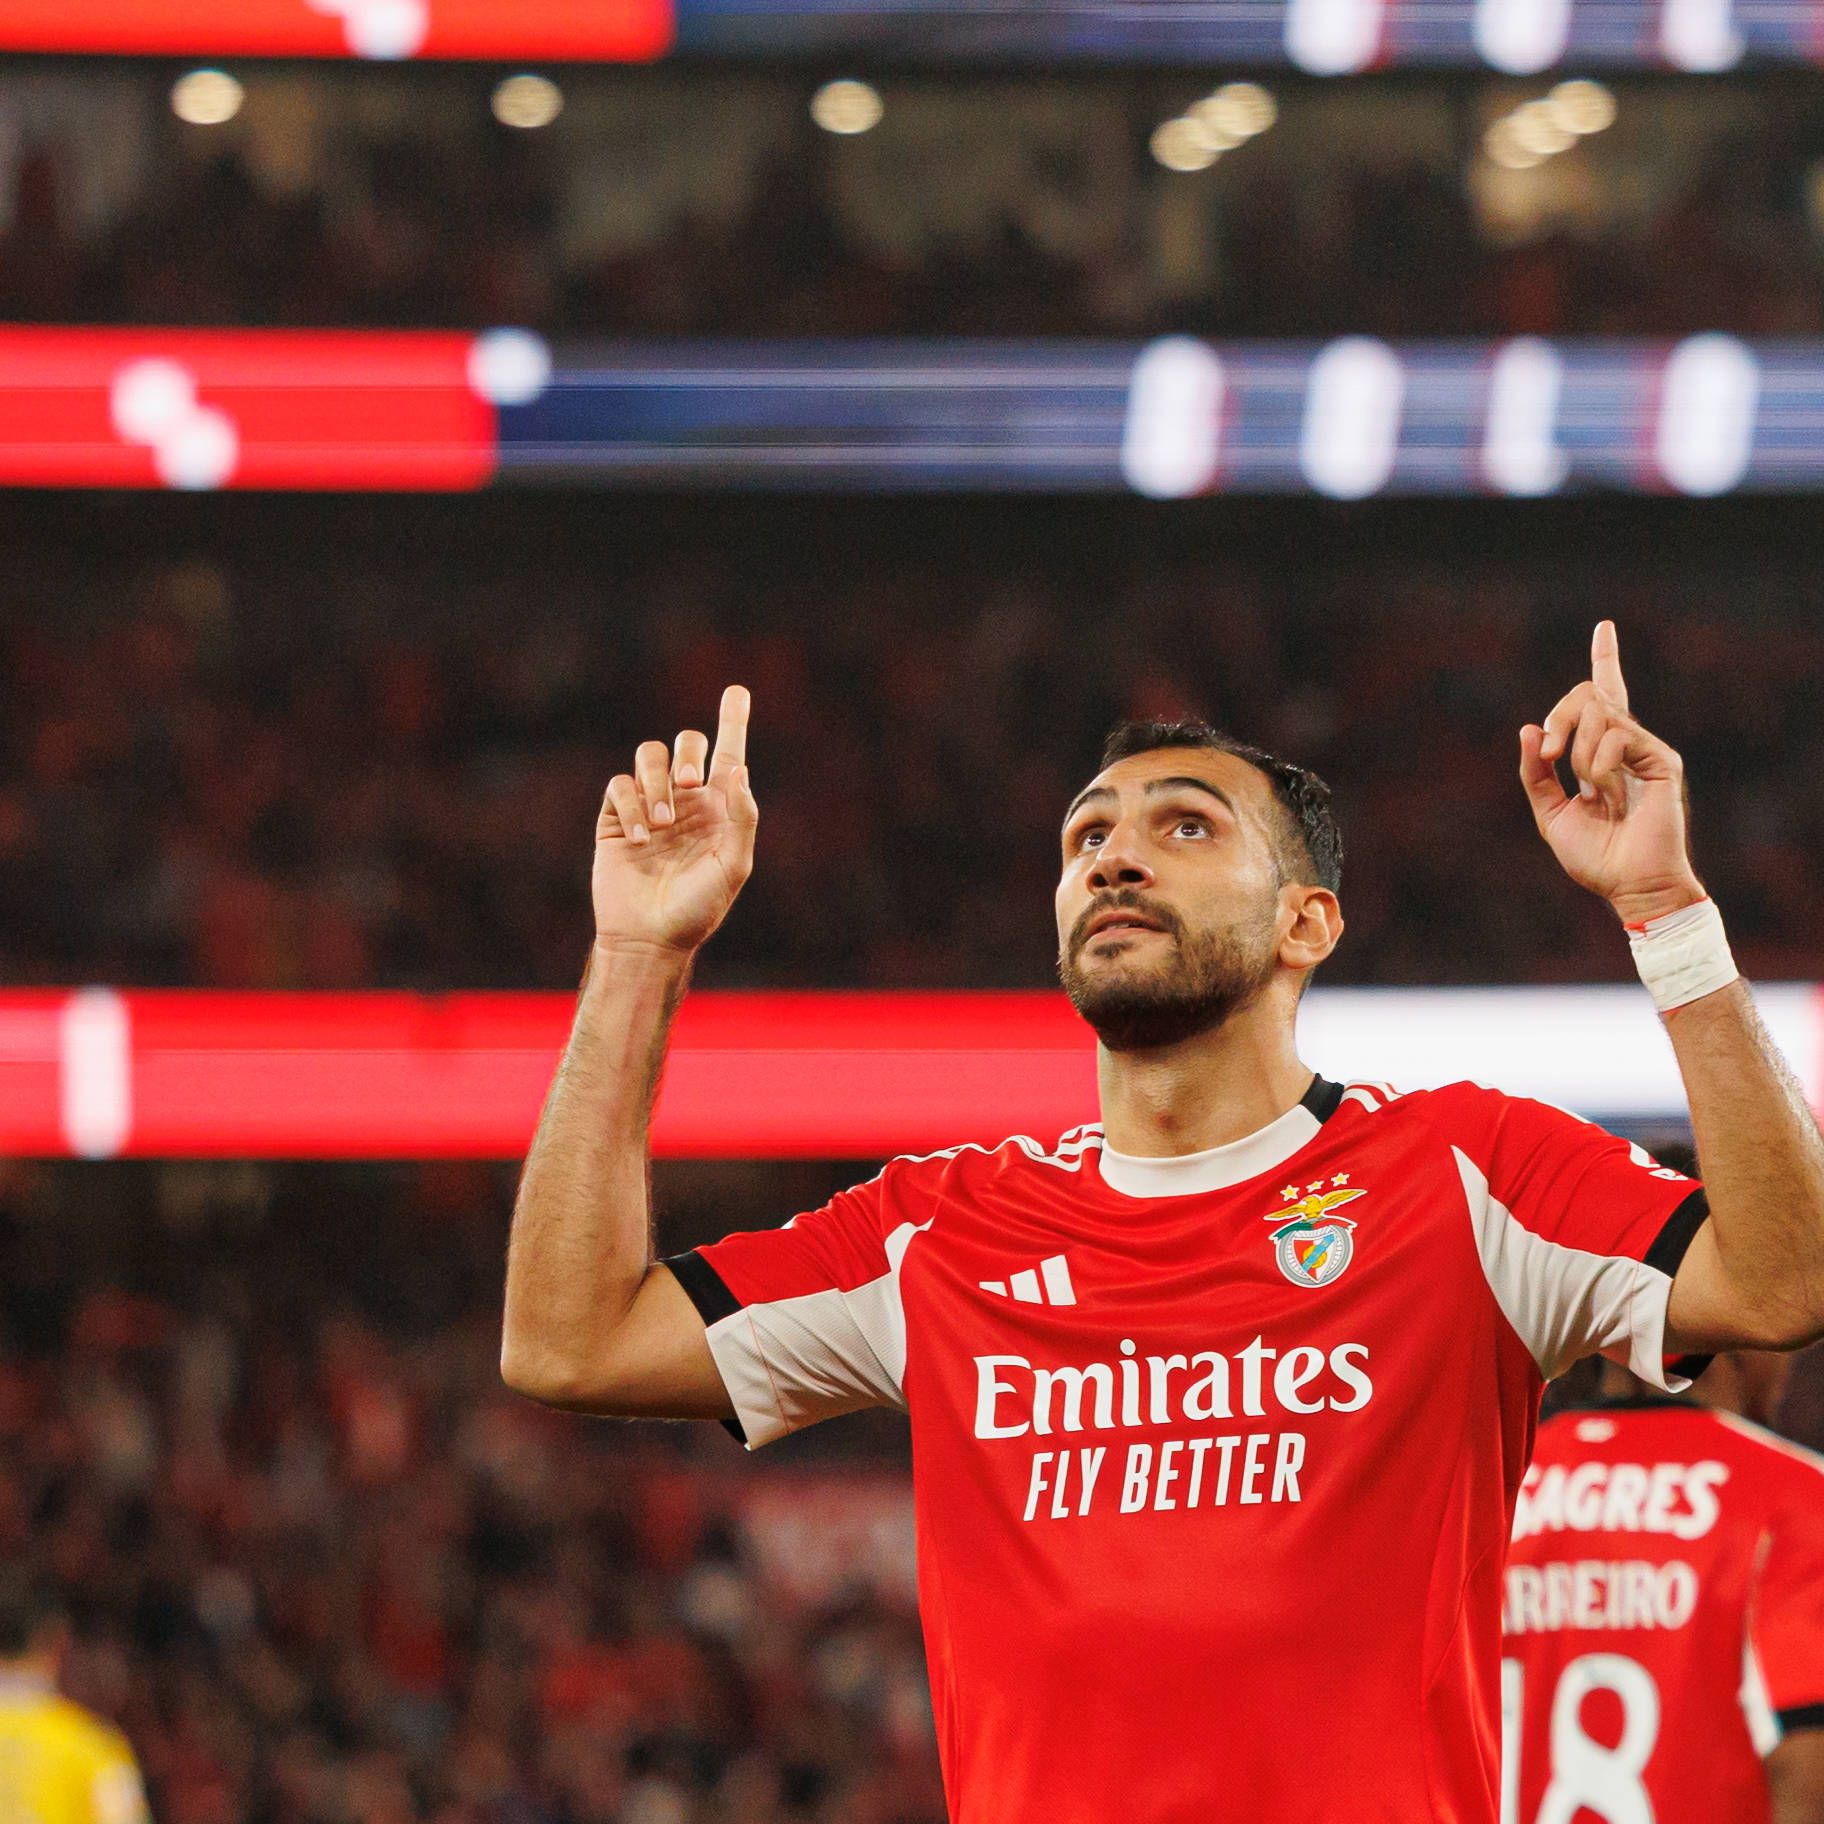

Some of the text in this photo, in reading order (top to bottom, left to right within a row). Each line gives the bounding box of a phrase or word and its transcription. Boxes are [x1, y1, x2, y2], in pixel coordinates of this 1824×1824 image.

[973, 1334, 1374, 1440] Emirates
[1022, 1432, 1307, 1522] FLY BETTER
